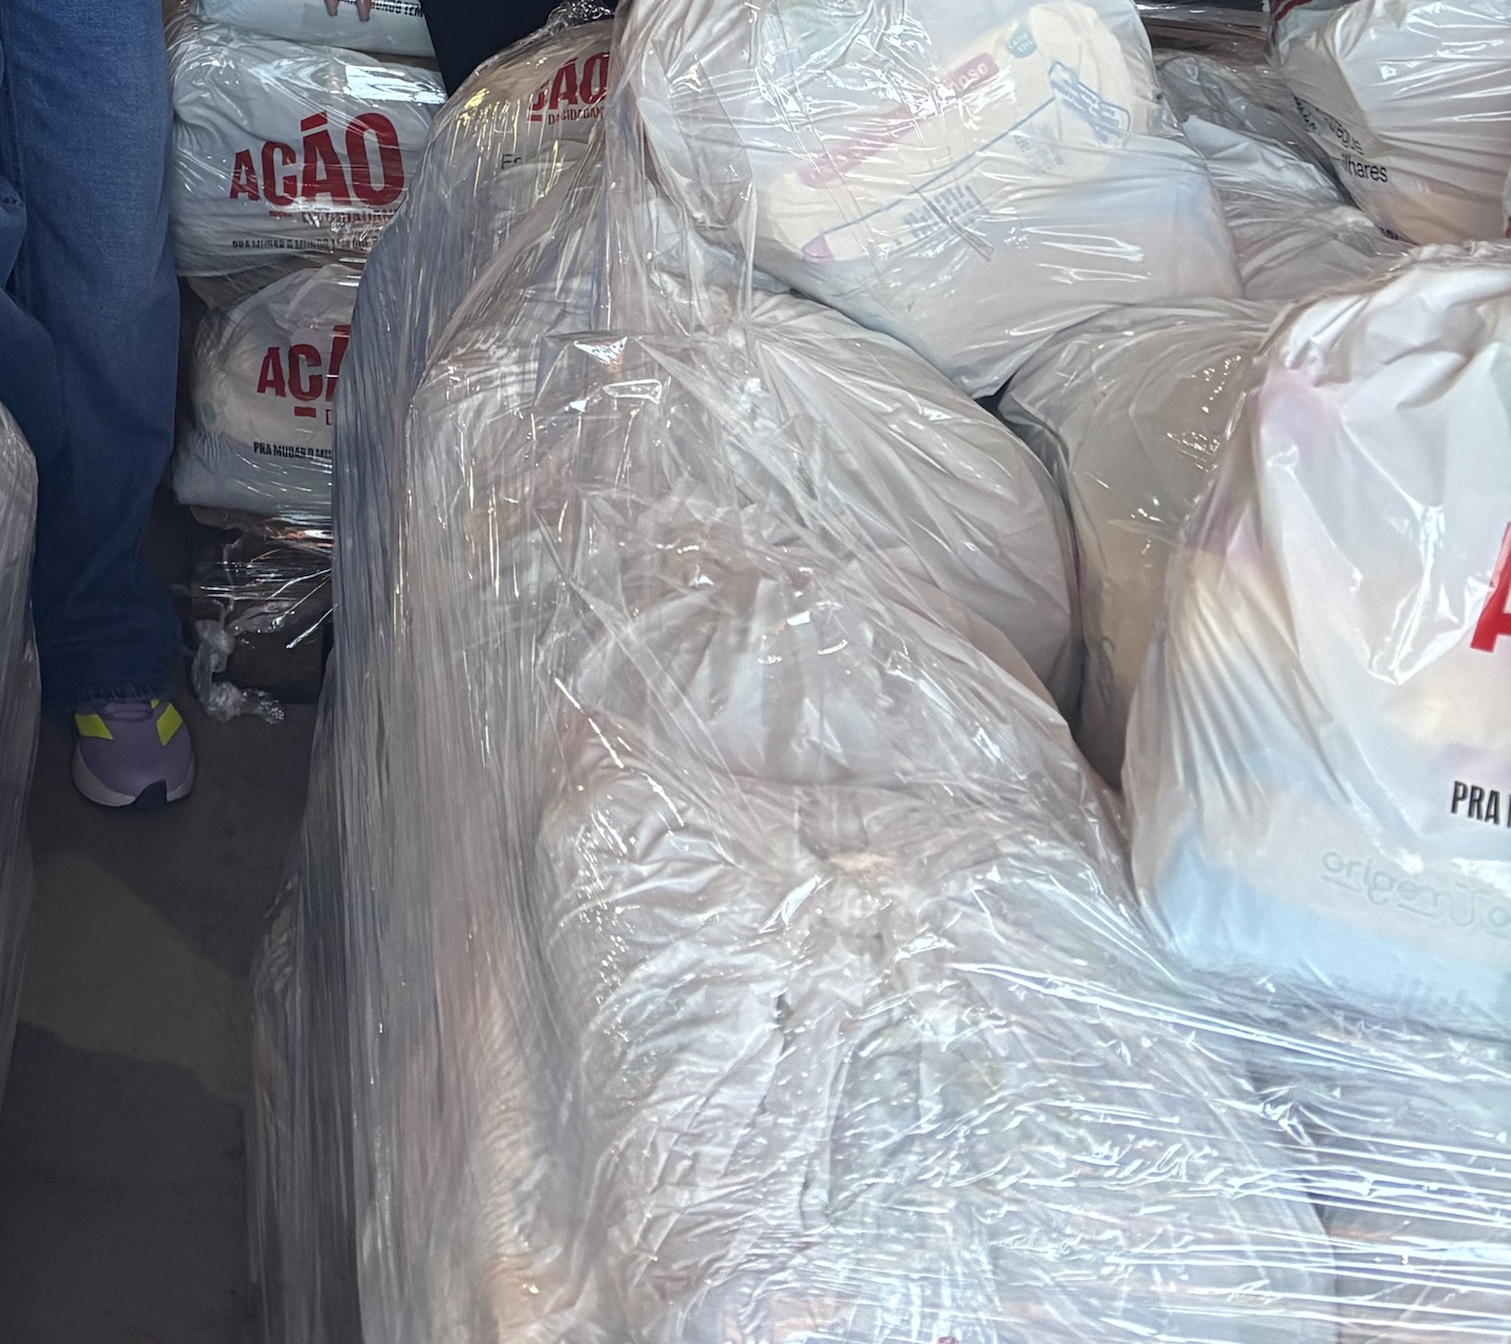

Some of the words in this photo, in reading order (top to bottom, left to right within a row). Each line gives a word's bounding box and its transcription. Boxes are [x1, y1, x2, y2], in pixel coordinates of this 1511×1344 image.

[230, 110, 405, 217] AÇÃO
[253, 441, 272, 455] PRA
[1451, 780, 1501, 826] PRA
